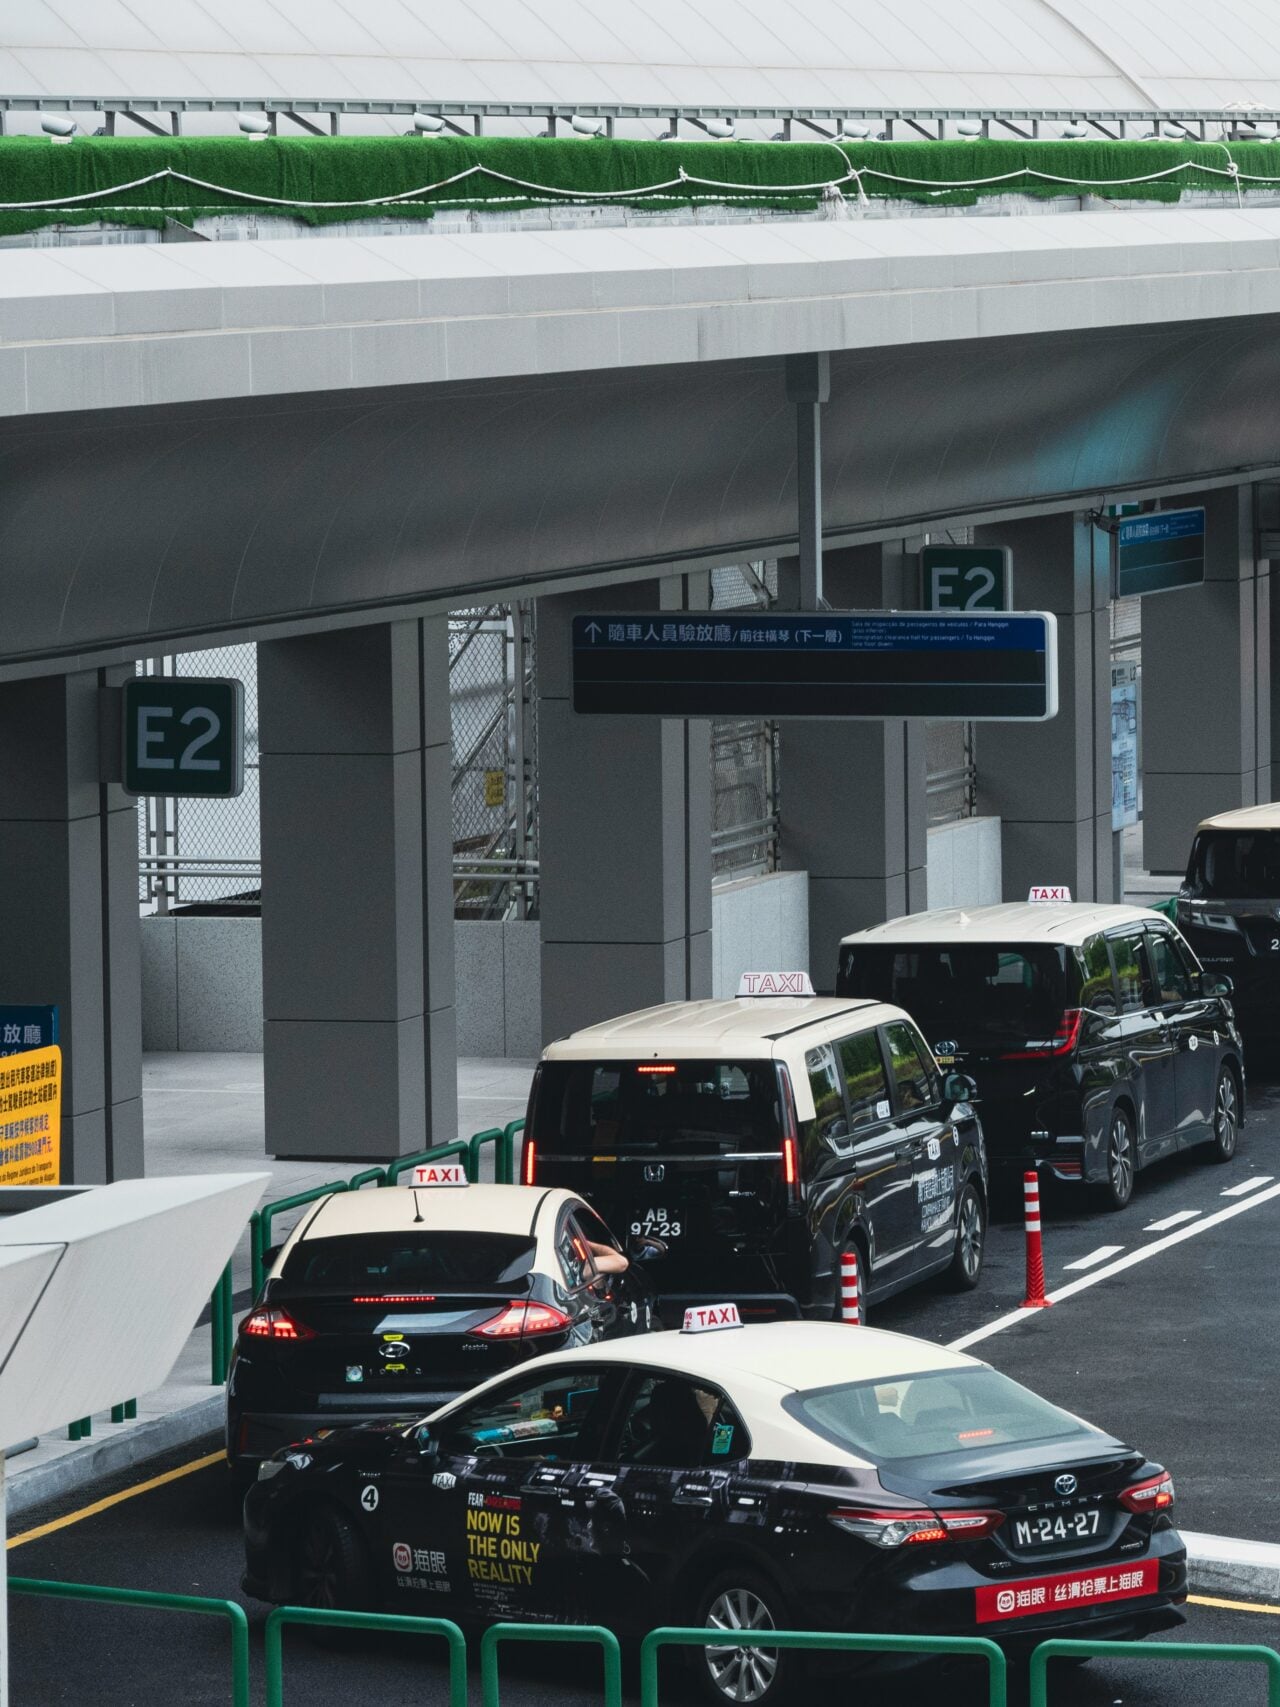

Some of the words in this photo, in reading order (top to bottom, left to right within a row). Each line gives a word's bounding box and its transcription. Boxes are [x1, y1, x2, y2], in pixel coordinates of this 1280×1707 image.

[932, 566, 995, 612] E2
[794, 630, 842, 643] (下一層)
[137, 706, 220, 771] E2
[1032, 889, 1064, 900] TAXI
[744, 974, 804, 992] TAXI
[0, 1023, 42, 1045] 放廳
[416, 1168, 458, 1182] TAXI
[646, 1208, 668, 1222] AB
[630, 1222, 680, 1236] 97-23
[696, 1308, 736, 1326] TAXI
[433, 1473, 456, 1488] TAXI
[362, 1488, 376, 1508] 4
[468, 1492, 484, 1508] FEAR
[466, 1510, 503, 1534] NOW
[506, 1514, 520, 1536] IS
[1016, 1510, 1100, 1545] M-24-27
[468, 1534, 497, 1558] THE
[500, 1539, 540, 1564] ONLY
[414, 1548, 448, 1574] 猫眼
[468, 1559, 532, 1586] REALITY
[1016, 1587, 1046, 1608] 猫眼
[1054, 1570, 1144, 1602] 丝滑抢票上猫眼
